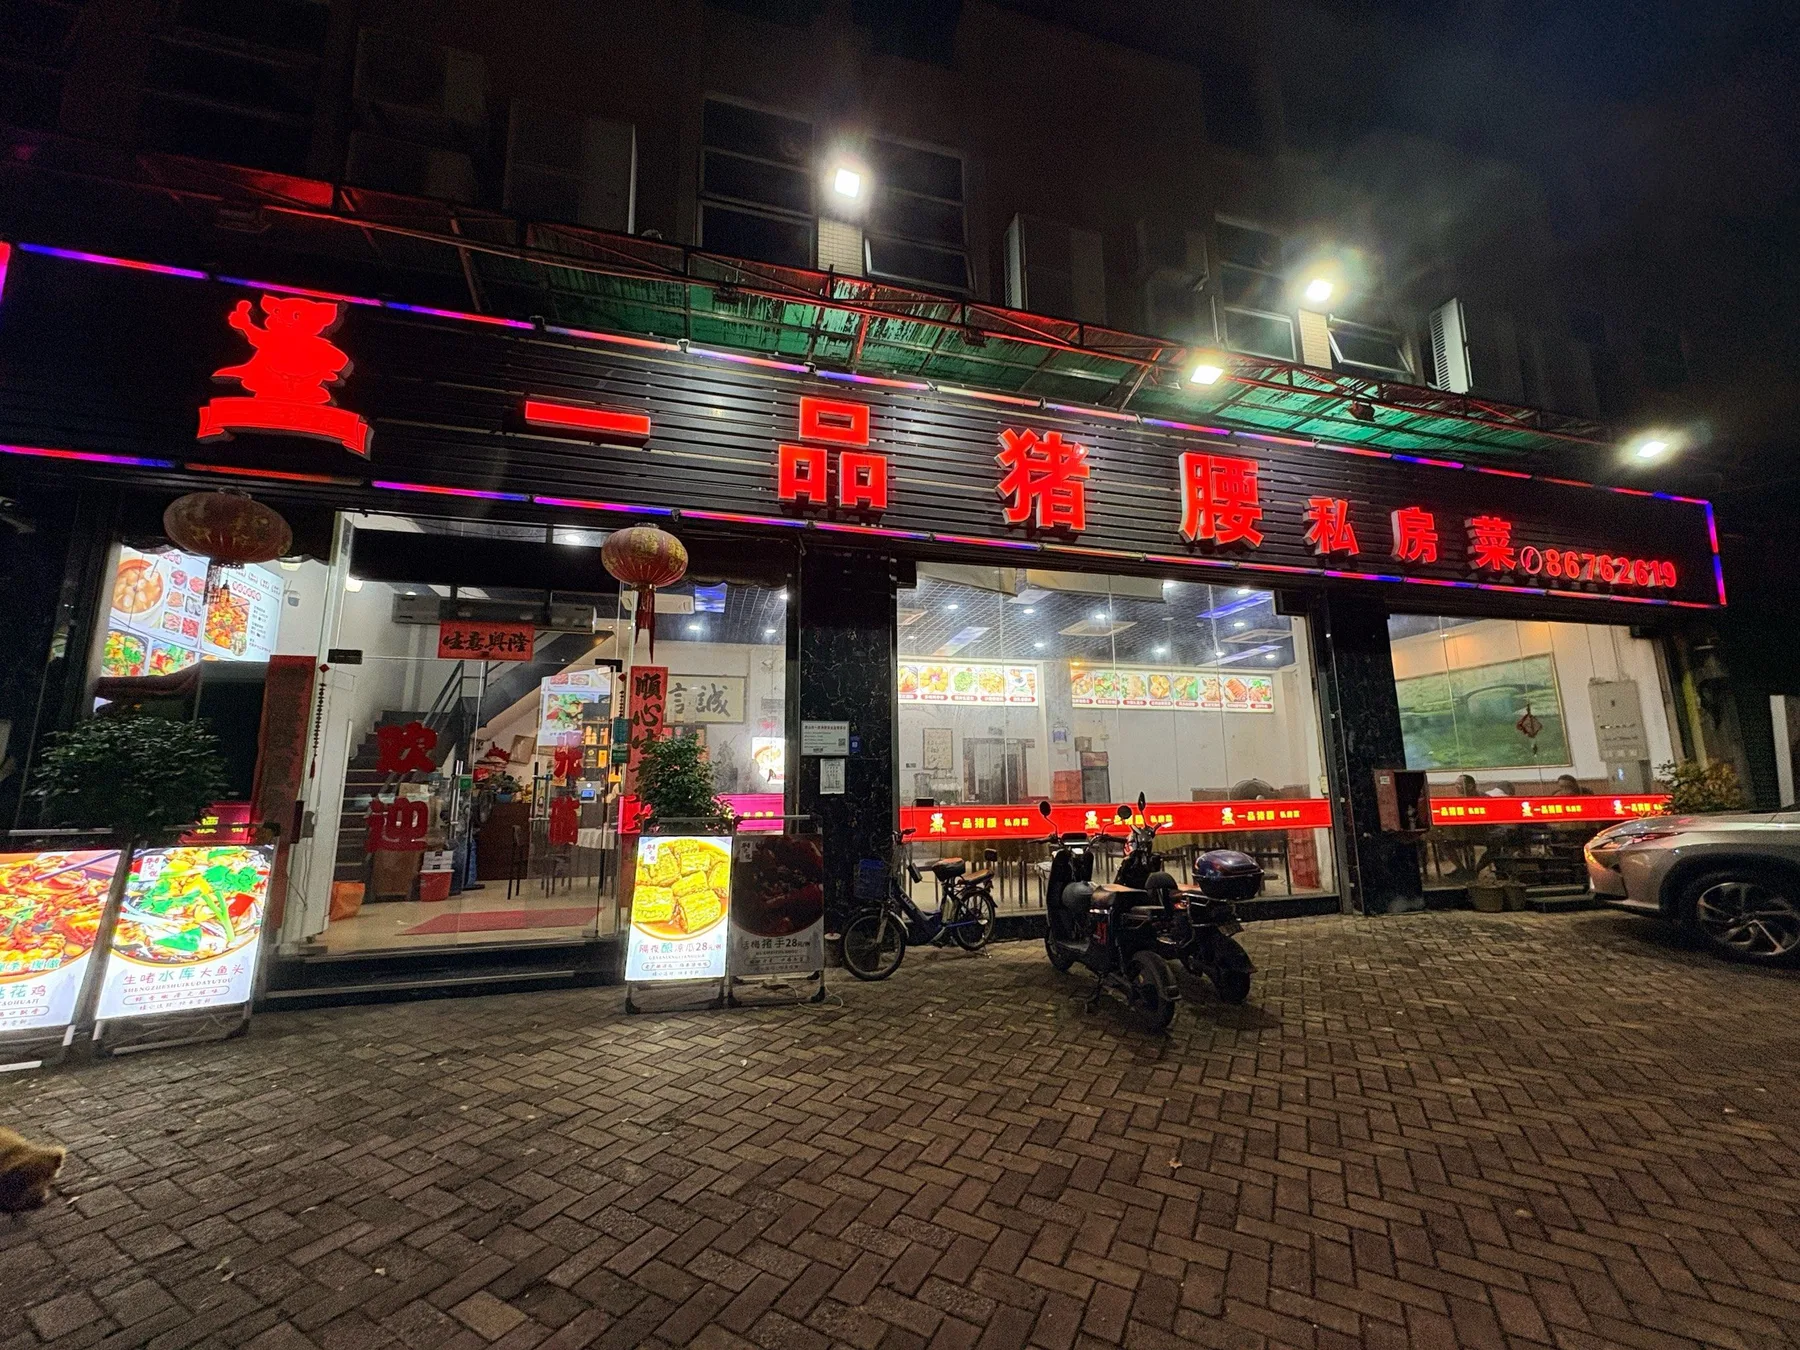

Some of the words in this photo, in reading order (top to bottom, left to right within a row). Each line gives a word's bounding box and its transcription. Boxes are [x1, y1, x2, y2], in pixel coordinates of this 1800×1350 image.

[1305, 496, 1518, 571] 私房菜
[1545, 548, 1677, 588] 86762619
[122, 964, 244, 986] 生啫水库大鱼头
